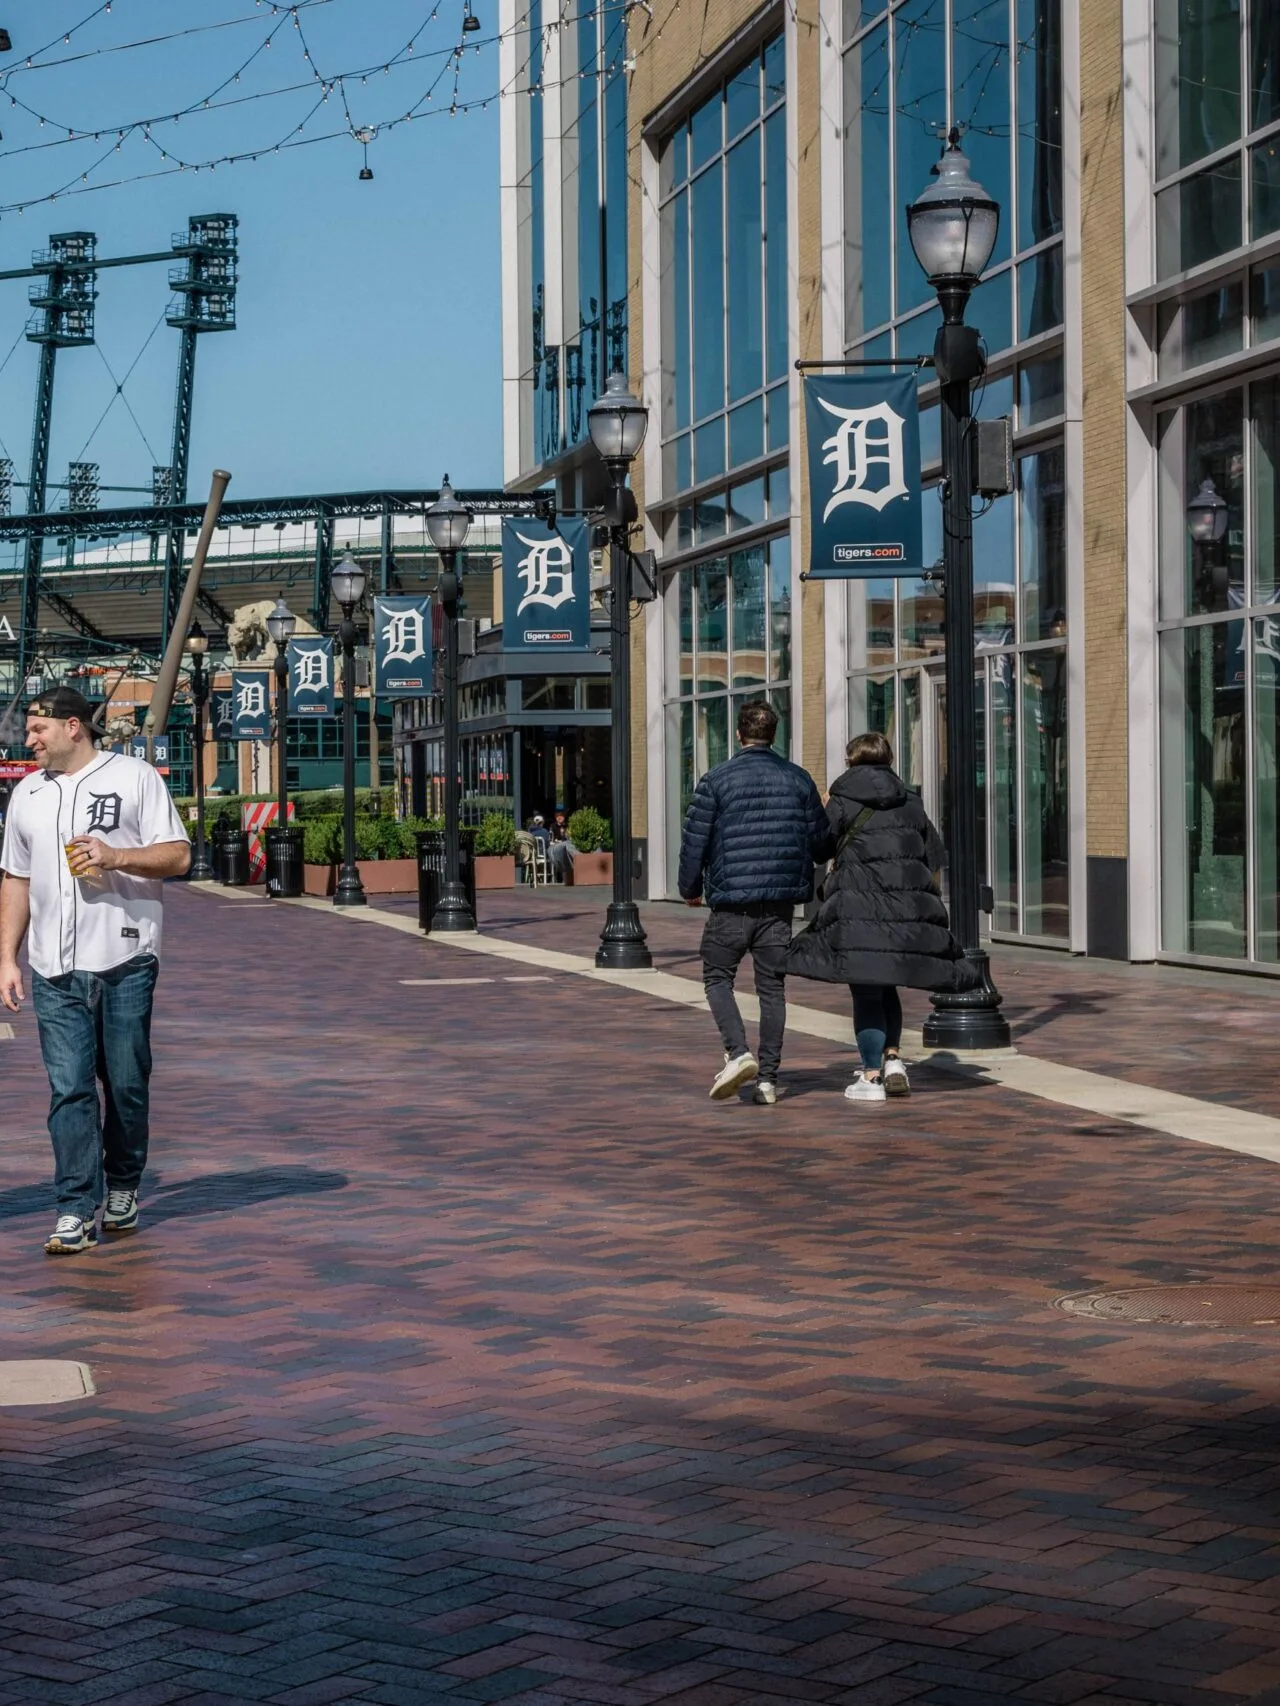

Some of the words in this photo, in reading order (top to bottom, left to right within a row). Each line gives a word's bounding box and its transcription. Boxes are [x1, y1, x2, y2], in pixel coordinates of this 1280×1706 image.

[817, 396, 910, 524] D
[515, 531, 576, 617] D
[837, 547, 900, 560] tigers.com
[380, 605, 426, 670] D
[526, 632, 569, 641] tigers.com
[293, 646, 329, 697] D
[388, 679, 421, 688] tigers.com
[236, 678, 266, 722] D
[87, 792, 123, 834] D
